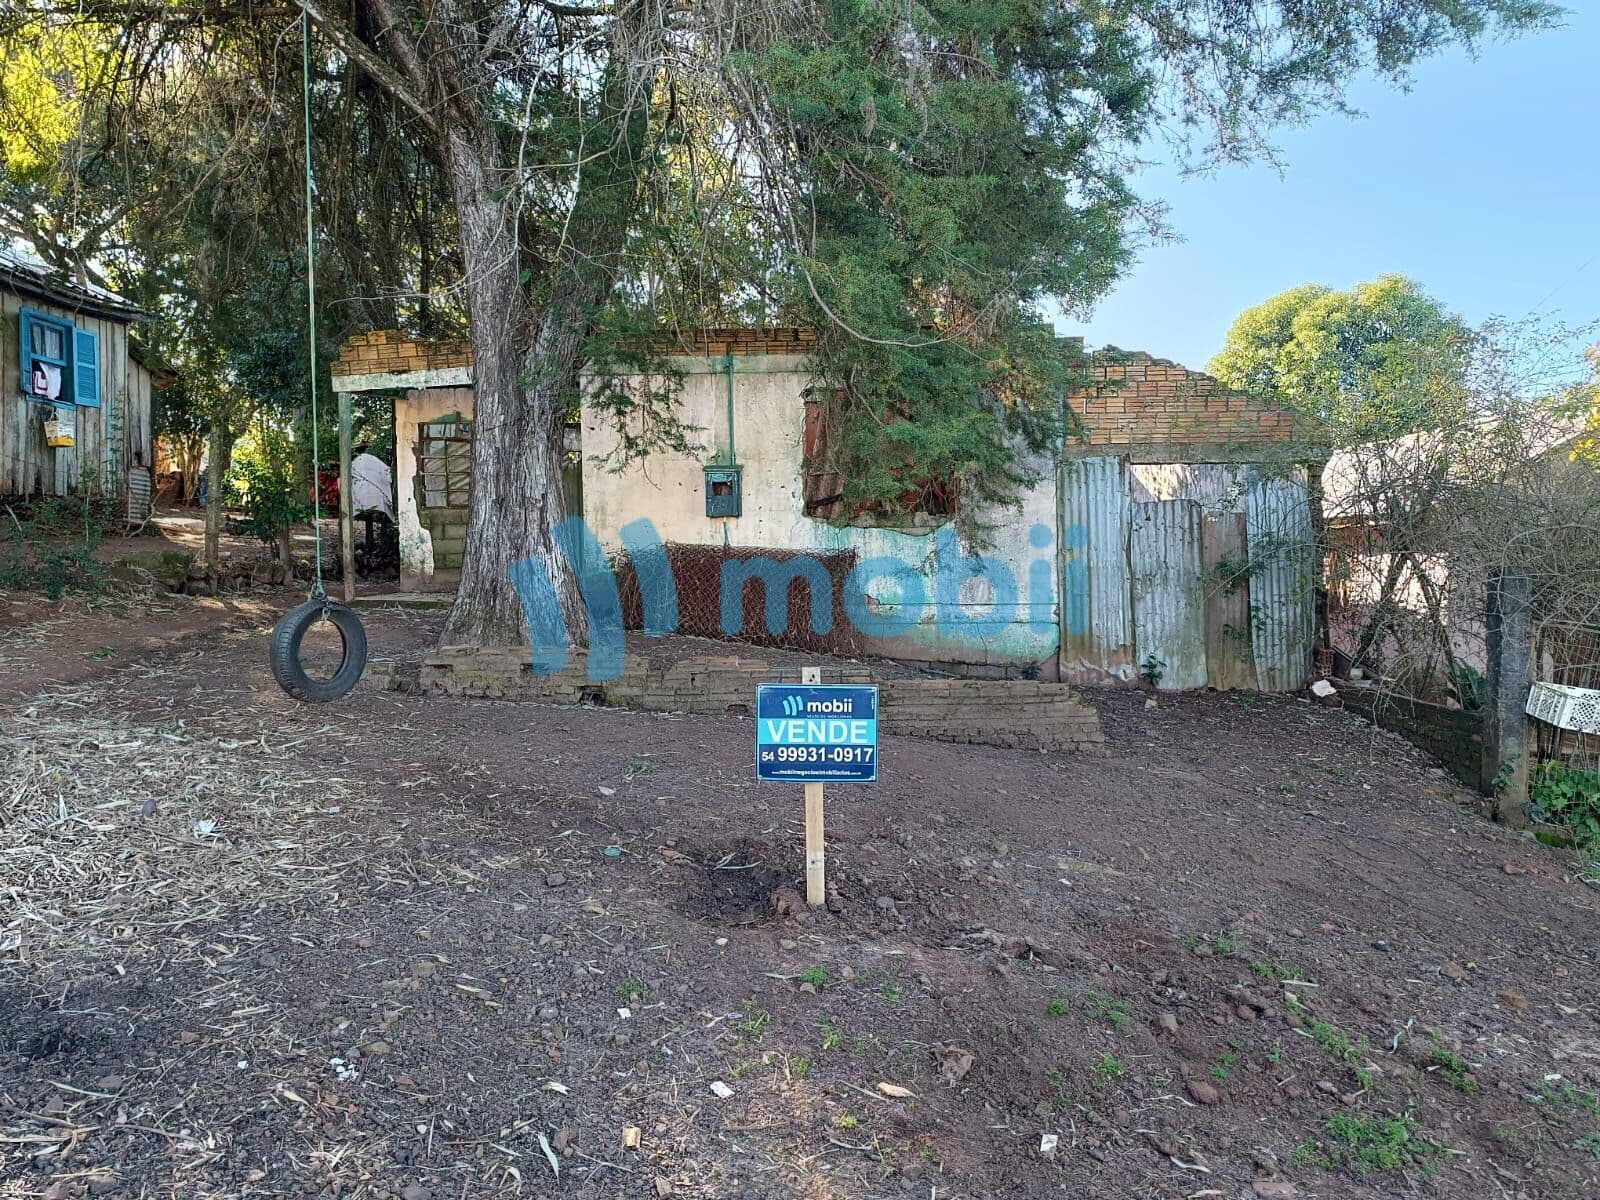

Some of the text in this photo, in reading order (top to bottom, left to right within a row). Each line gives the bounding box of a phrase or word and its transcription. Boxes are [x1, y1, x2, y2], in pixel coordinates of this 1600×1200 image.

[807, 698, 853, 713] mobii
[767, 720, 869, 744] VENDE
[761, 747, 874, 762] 54 99931-0917
